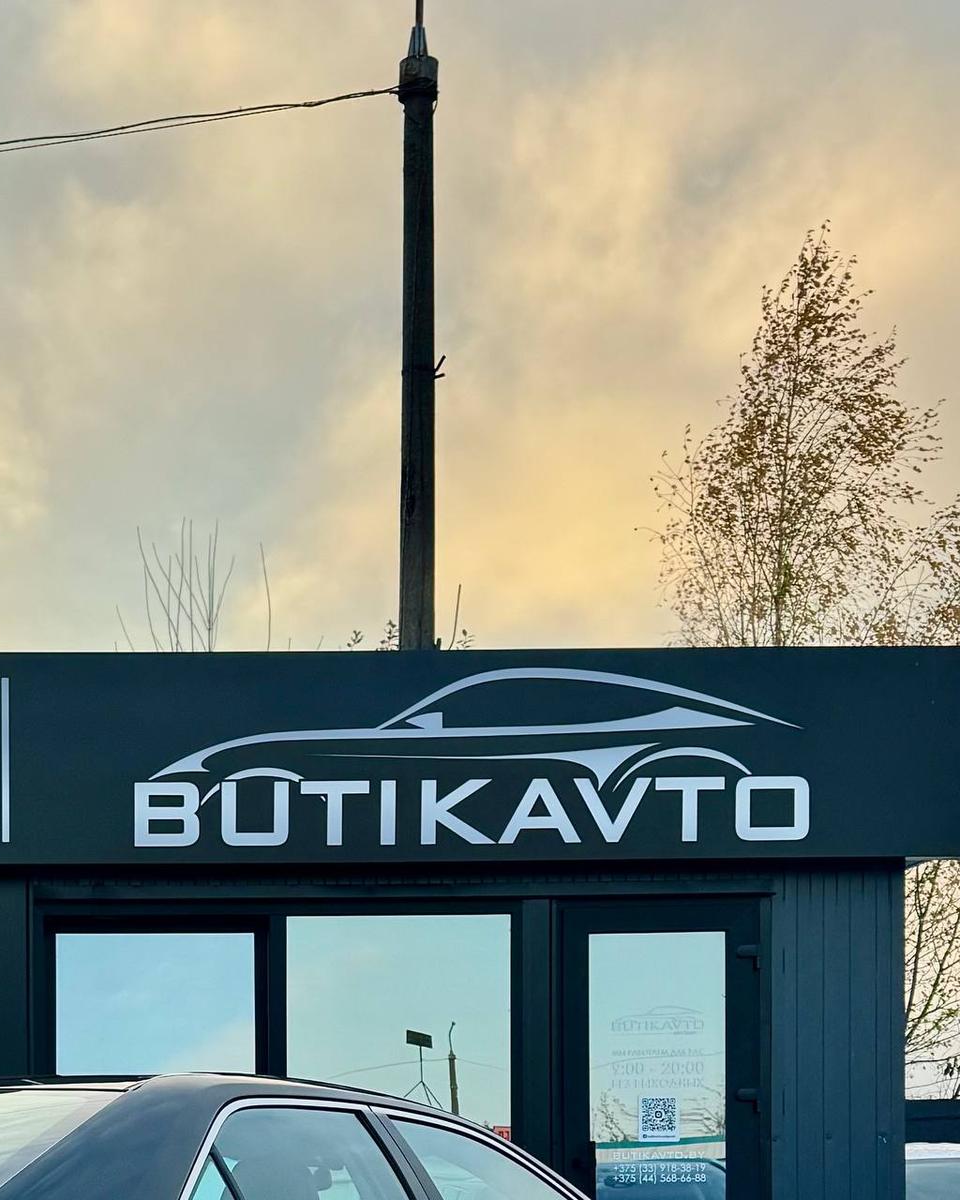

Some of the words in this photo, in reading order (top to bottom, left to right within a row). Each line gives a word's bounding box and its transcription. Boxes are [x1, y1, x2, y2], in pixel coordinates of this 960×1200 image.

[133, 776, 810, 848] BUTIKAVTO
[611, 1062, 644, 1076] 9:00
[661, 1061, 704, 1074] 20:00
[613, 1164, 636, 1172] +375
[639, 1164, 657, 1174] (33)
[660, 1163, 706, 1172] 918-38-19
[613, 1174, 636, 1183] +375
[639, 1174, 657, 1184] (44)
[660, 1174, 707, 1183] 568-66-88
